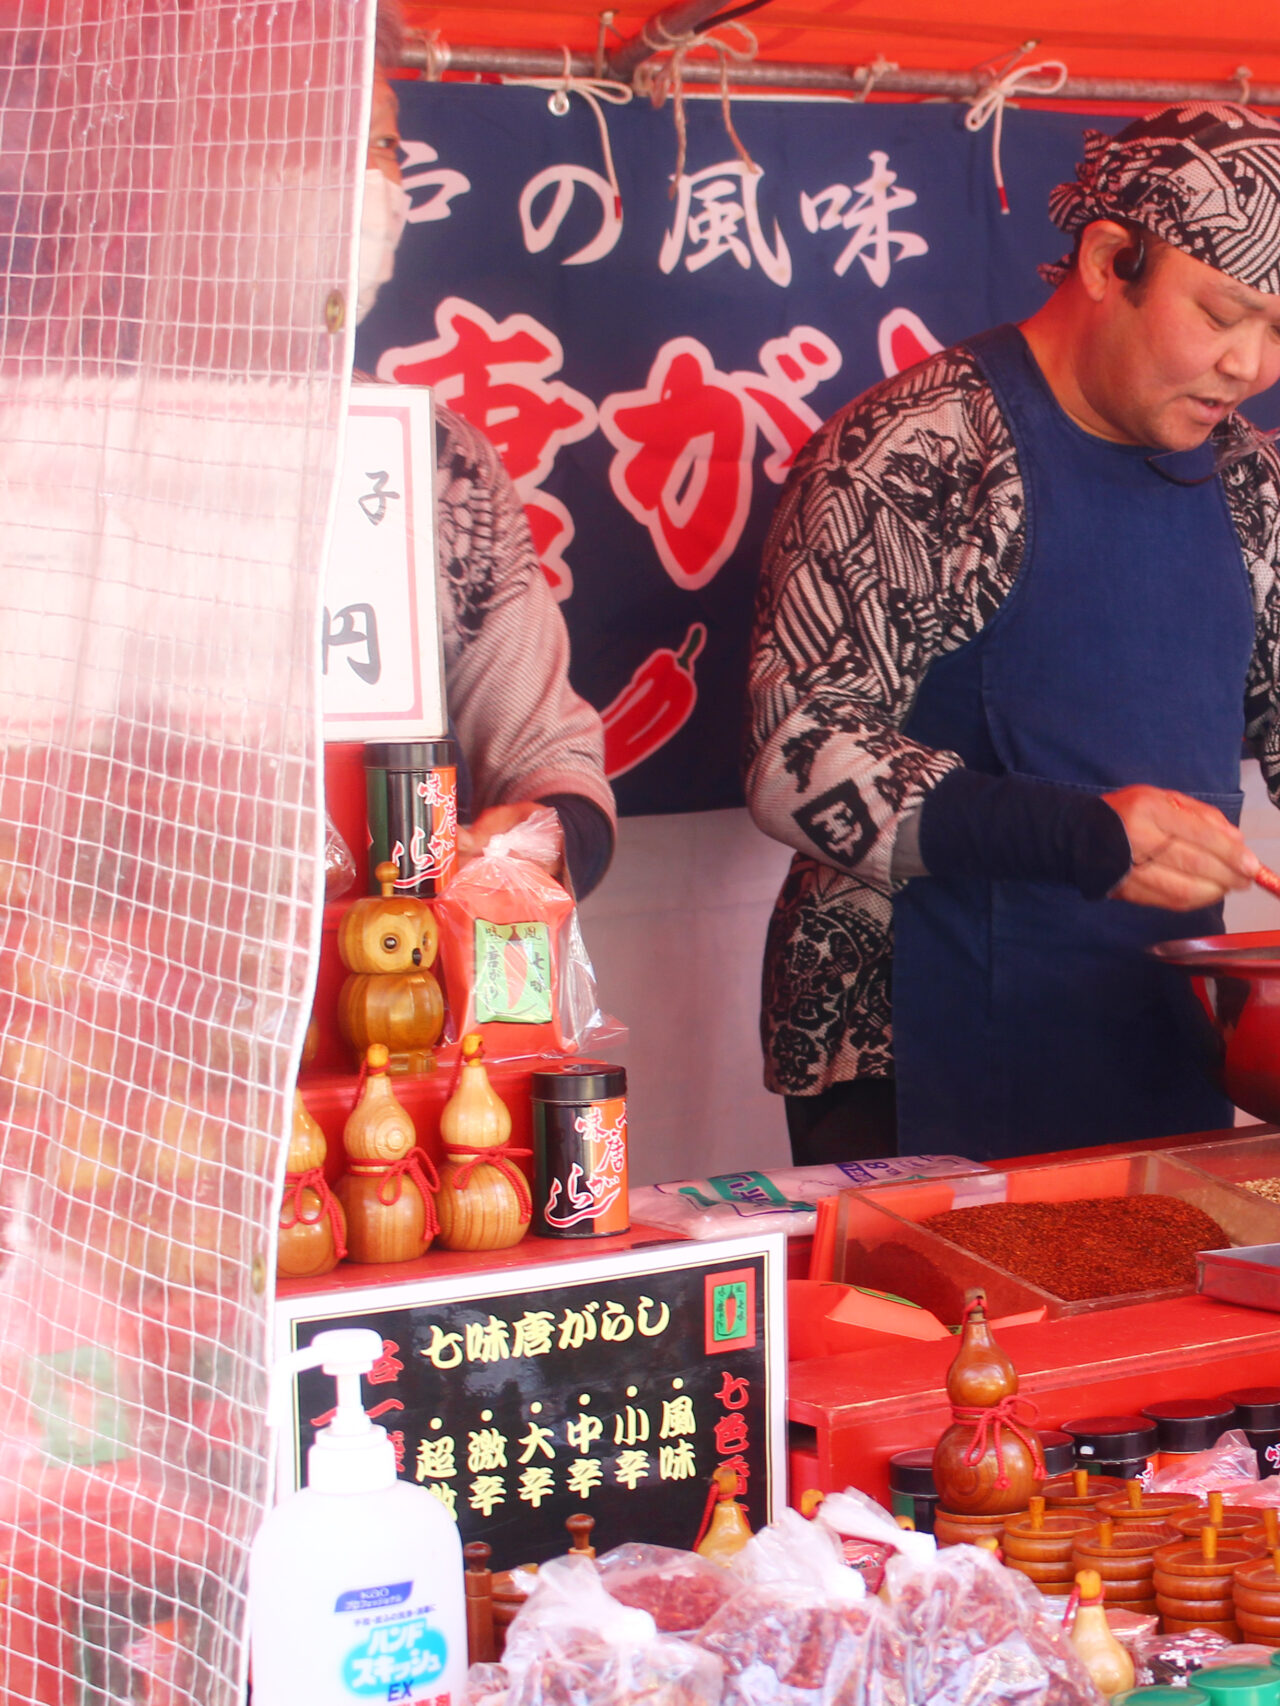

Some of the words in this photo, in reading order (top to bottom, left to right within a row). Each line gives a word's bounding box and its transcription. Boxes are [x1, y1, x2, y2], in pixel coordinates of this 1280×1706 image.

[420, 1296, 671, 1370] 七味唐がらし
[468, 1427, 509, 1517] 激辛
[517, 1422, 556, 1508] 大辛
[566, 1412, 603, 1499] 中辛
[614, 1405, 651, 1491] 小辛
[659, 1395, 697, 1481] 風味
[367, 1621, 425, 1657] ハンド
[387, 1680, 414, 1702] EX
